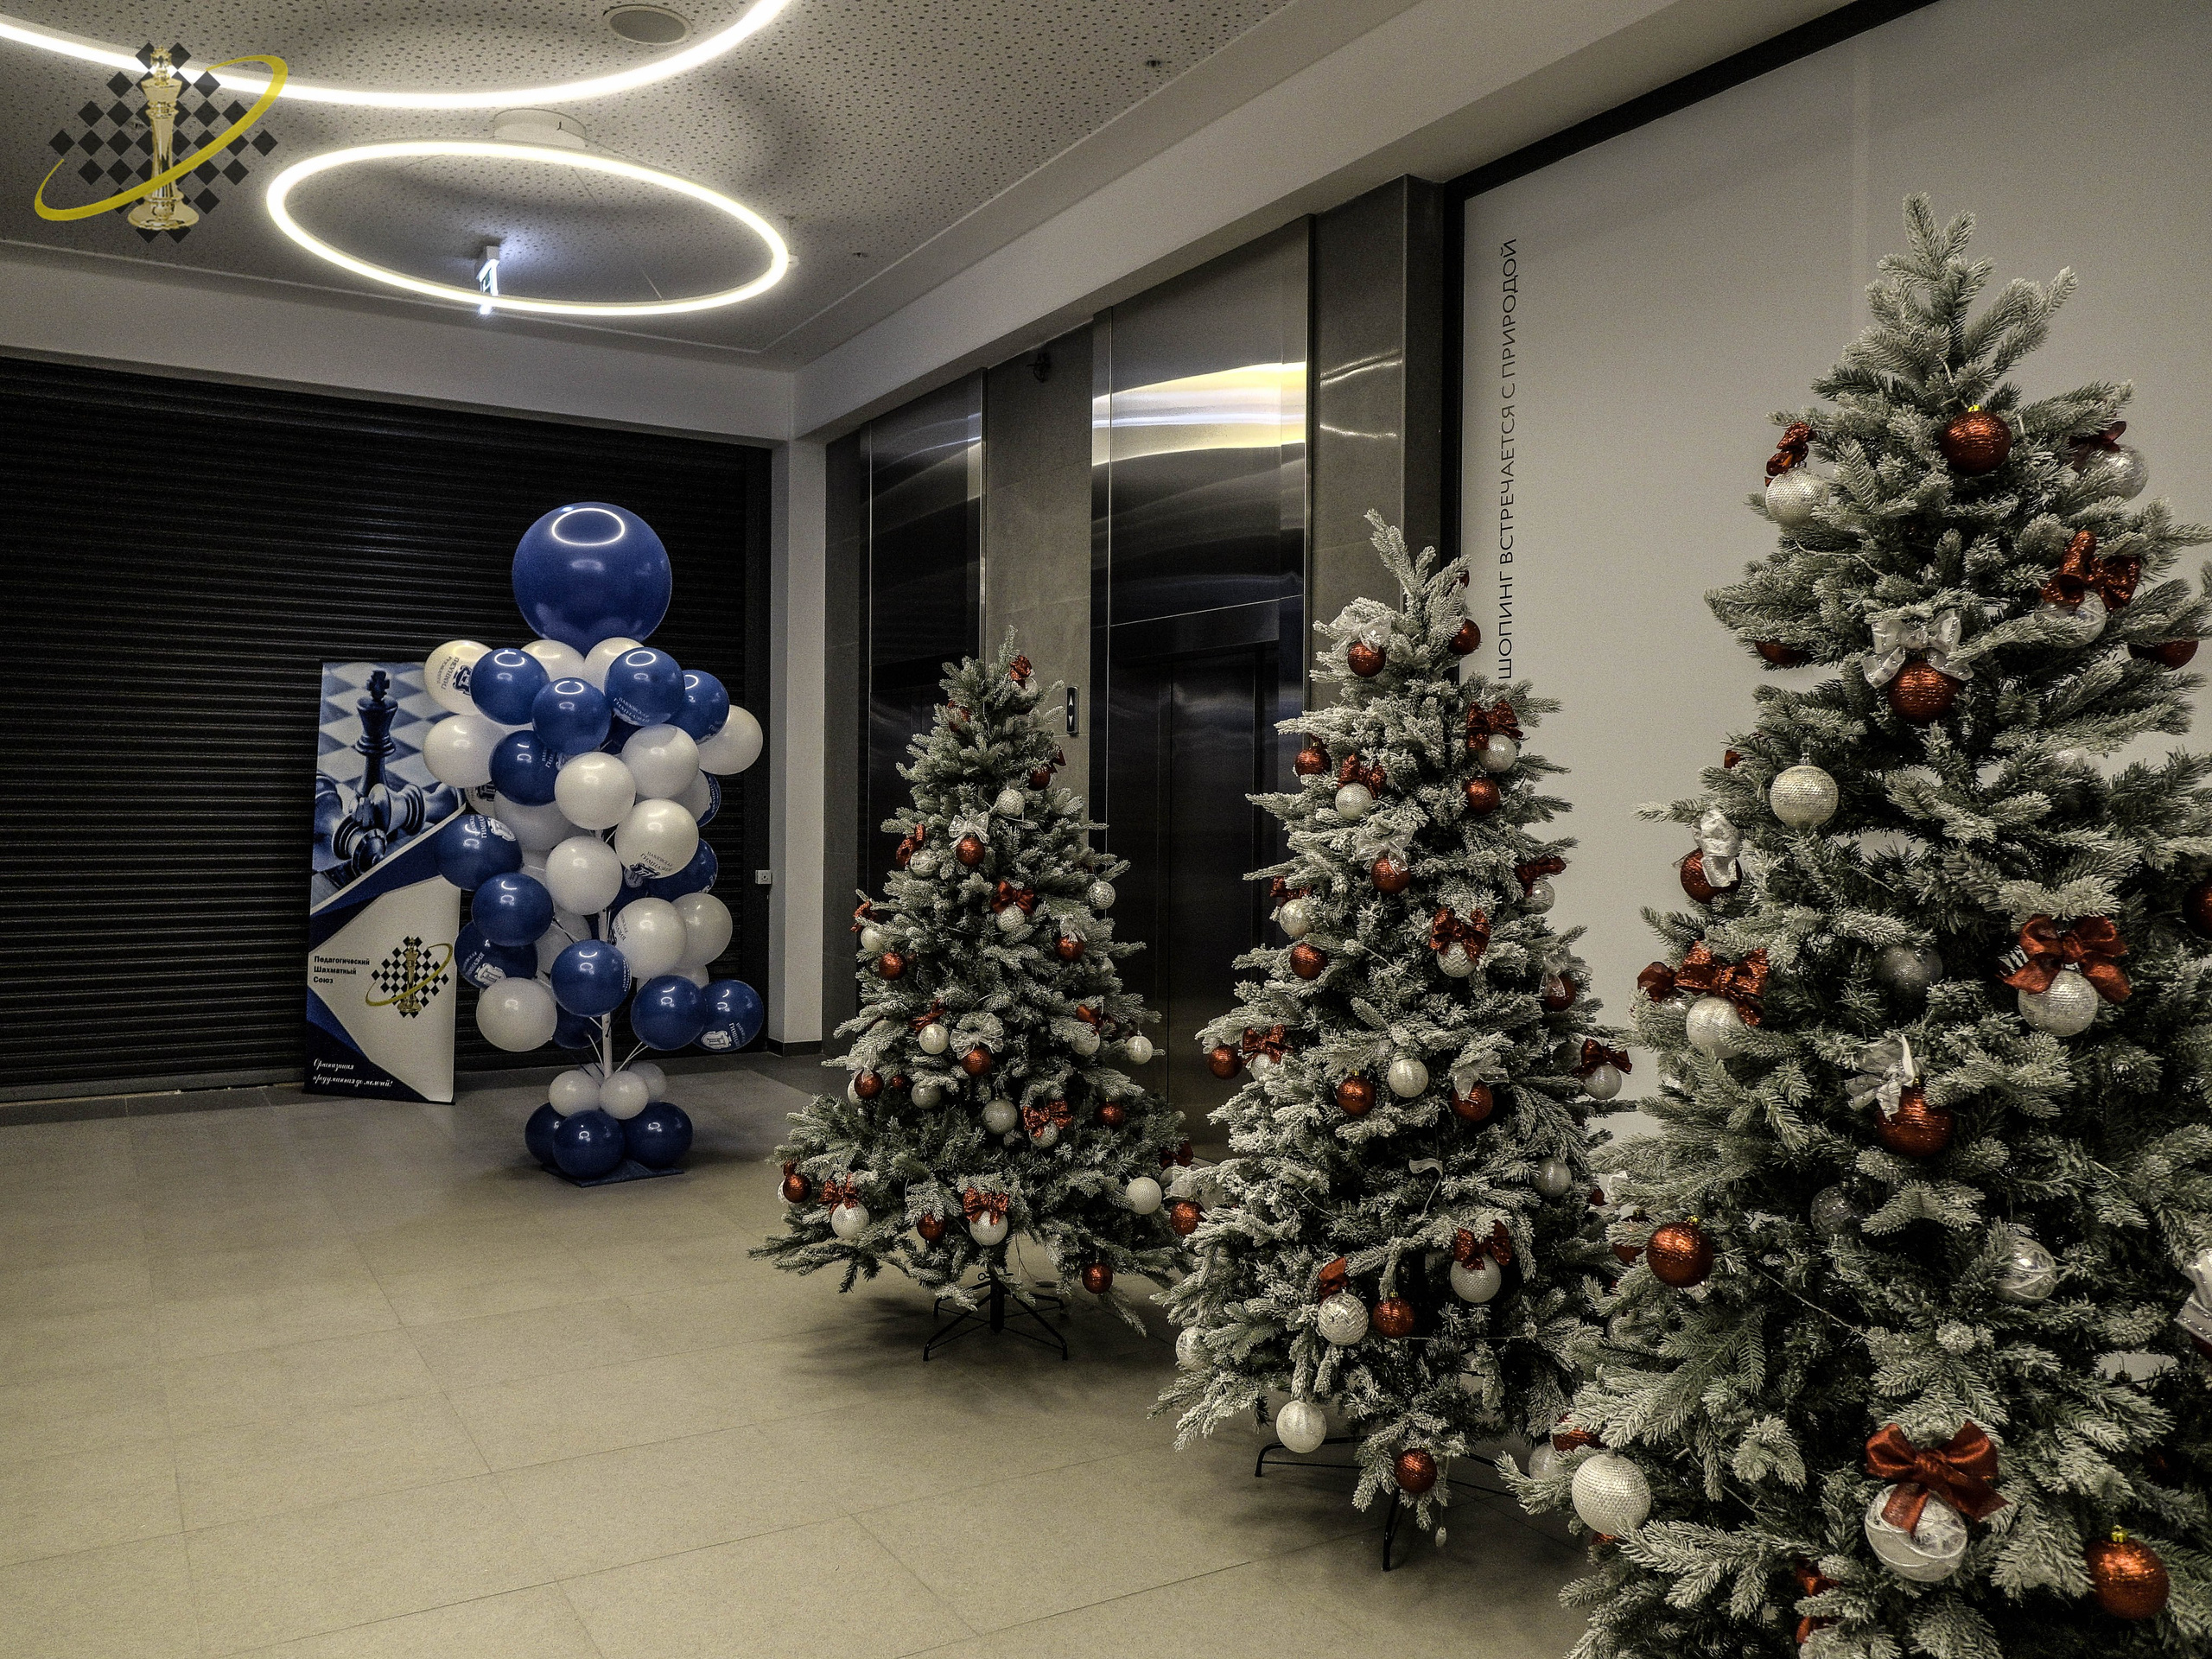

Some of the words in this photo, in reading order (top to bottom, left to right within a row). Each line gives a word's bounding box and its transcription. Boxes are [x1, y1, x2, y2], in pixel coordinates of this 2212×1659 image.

[1500, 238, 1519, 378] ПРИРОДОЙ
[1502, 383, 1516, 399] С
[1500, 404, 1516, 564] ВСТРЕЧАЕТСЯ
[1498, 570, 1513, 680] ШОПИНГ
[314, 956, 370, 966] Педагогический
[314, 965, 357, 975] Шахматный
[313, 976, 334, 984] Союз
[313, 1058, 355, 1071] Организация
